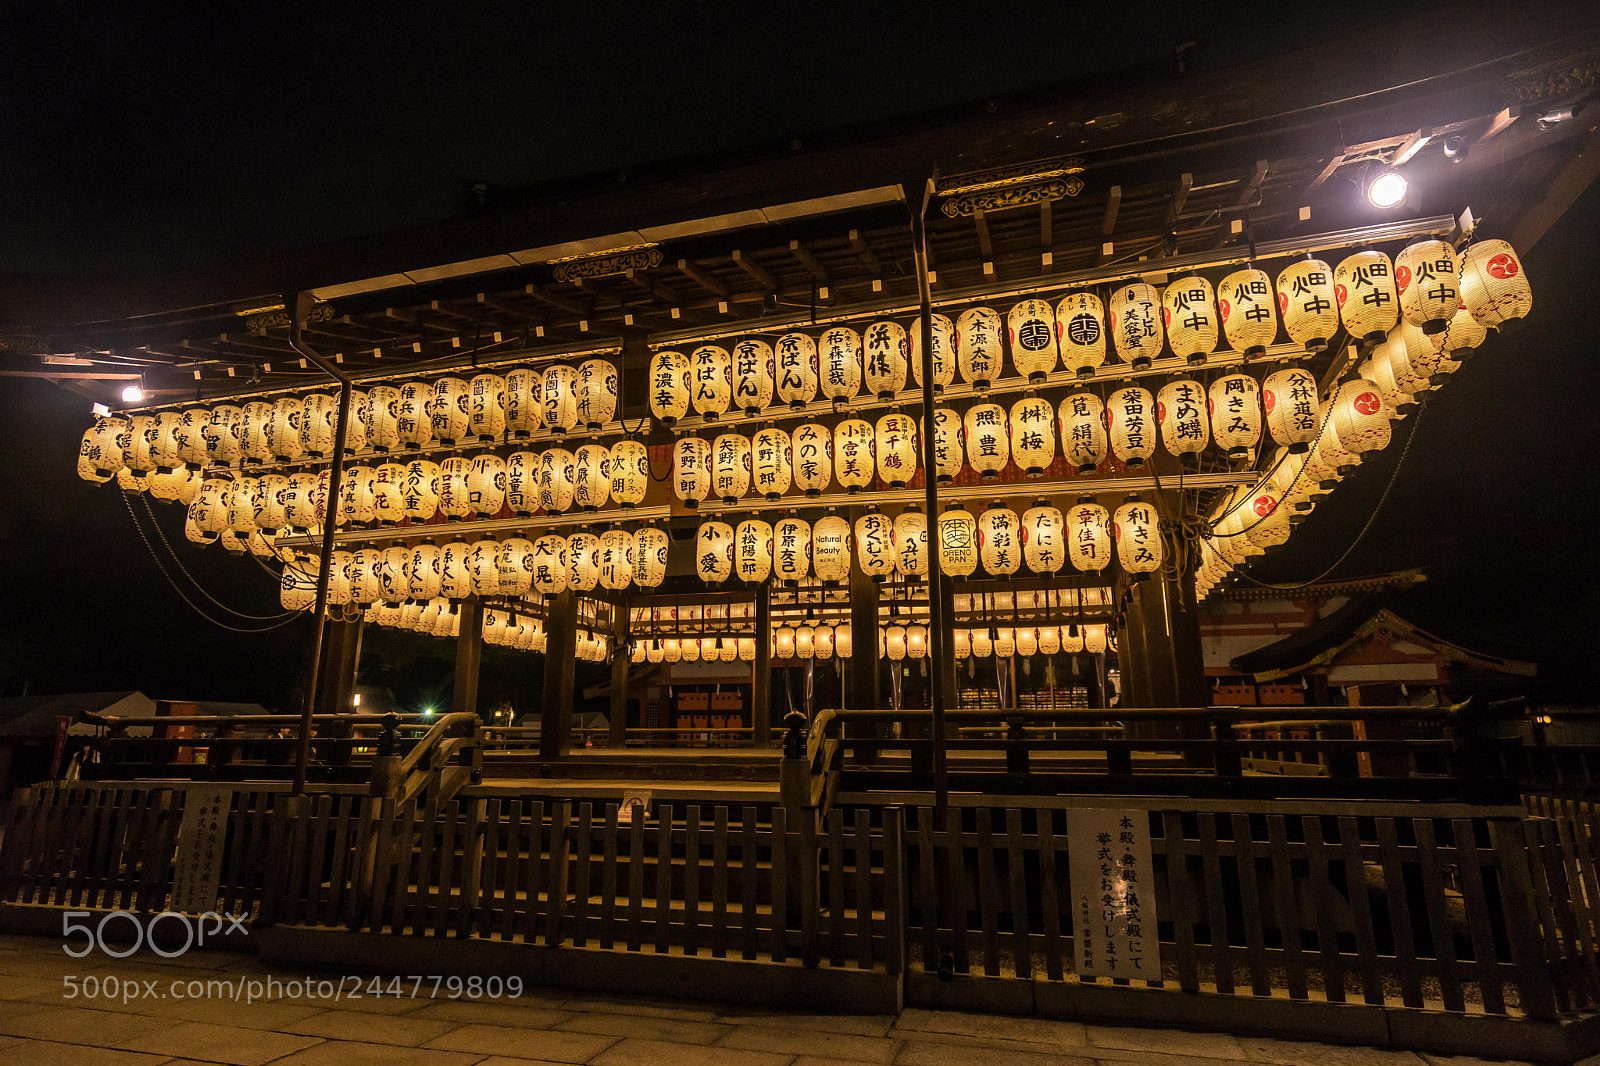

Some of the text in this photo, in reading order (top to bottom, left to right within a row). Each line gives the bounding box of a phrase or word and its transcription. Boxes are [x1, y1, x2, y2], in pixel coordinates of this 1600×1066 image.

[1234, 281, 1271, 322] 畑中
[1293, 272, 1331, 315] 畑中
[1351, 263, 1391, 307] 畑中
[1416, 259, 1456, 303] 畑中
[1123, 308, 1143, 350] 美容室
[1174, 289, 1208, 331] 畑中
[779, 334, 802, 390] 京ばん
[826, 330, 846, 386] 祐森正哉
[968, 310, 991, 373] 八木源太郎
[655, 354, 674, 409] 美濃幸
[696, 348, 716, 401] 京ばん
[737, 341, 759, 398] 京ばん
[399, 386, 417, 433] 権兵衛
[432, 381, 449, 429] 権兵衛
[1122, 389, 1145, 449] 柴田芳豆
[1175, 384, 1203, 440] まめ蝶
[1224, 378, 1251, 433] 岡きみ
[1287, 372, 1315, 430] 分林道治
[207, 411, 221, 451] 辻留
[799, 426, 818, 480] みの家
[842, 424, 860, 477] 小富美
[884, 418, 903, 469] 豆千鶴
[976, 409, 999, 457] 照豊
[469, 459, 486, 503] 川口
[508, 454, 523, 506] 茂山童司
[612, 455, 625, 493] 次朗
[680, 441, 696, 493] 矢野一郎
[718, 438, 733, 489] 矢野一郎
[758, 434, 775, 486] 矢野一郎
[254, 479, 266, 520] キメラ
[285, 479, 299, 519] 池田家
[344, 469, 359, 514] 田崎真也
[373, 468, 390, 510] 豆花
[405, 462, 424, 510] 美の八重
[701, 526, 721, 573] 小愛
[742, 523, 758, 575] 小松陽一郎
[780, 523, 799, 573] 伊原友己
[816, 535, 842, 544] Natural
[816, 547, 841, 556] Beauty
[865, 516, 885, 568] おくむら
[943, 548, 972, 557] ORENO
[991, 514, 1011, 568] 満彩美
[1036, 513, 1054, 566] たに本
[1077, 508, 1096, 559] 章佳司
[1128, 507, 1155, 563] 利きみ
[351, 552, 364, 599] 元奈古
[535, 541, 553, 584] 大晃
[570, 537, 584, 585] 花さくら
[603, 549, 615, 584] 吉川
[1096, 832, 1119, 970] 挙式をお受けします
[1119, 815, 1143, 970] 本殿・舞殿・儀式殿にて
